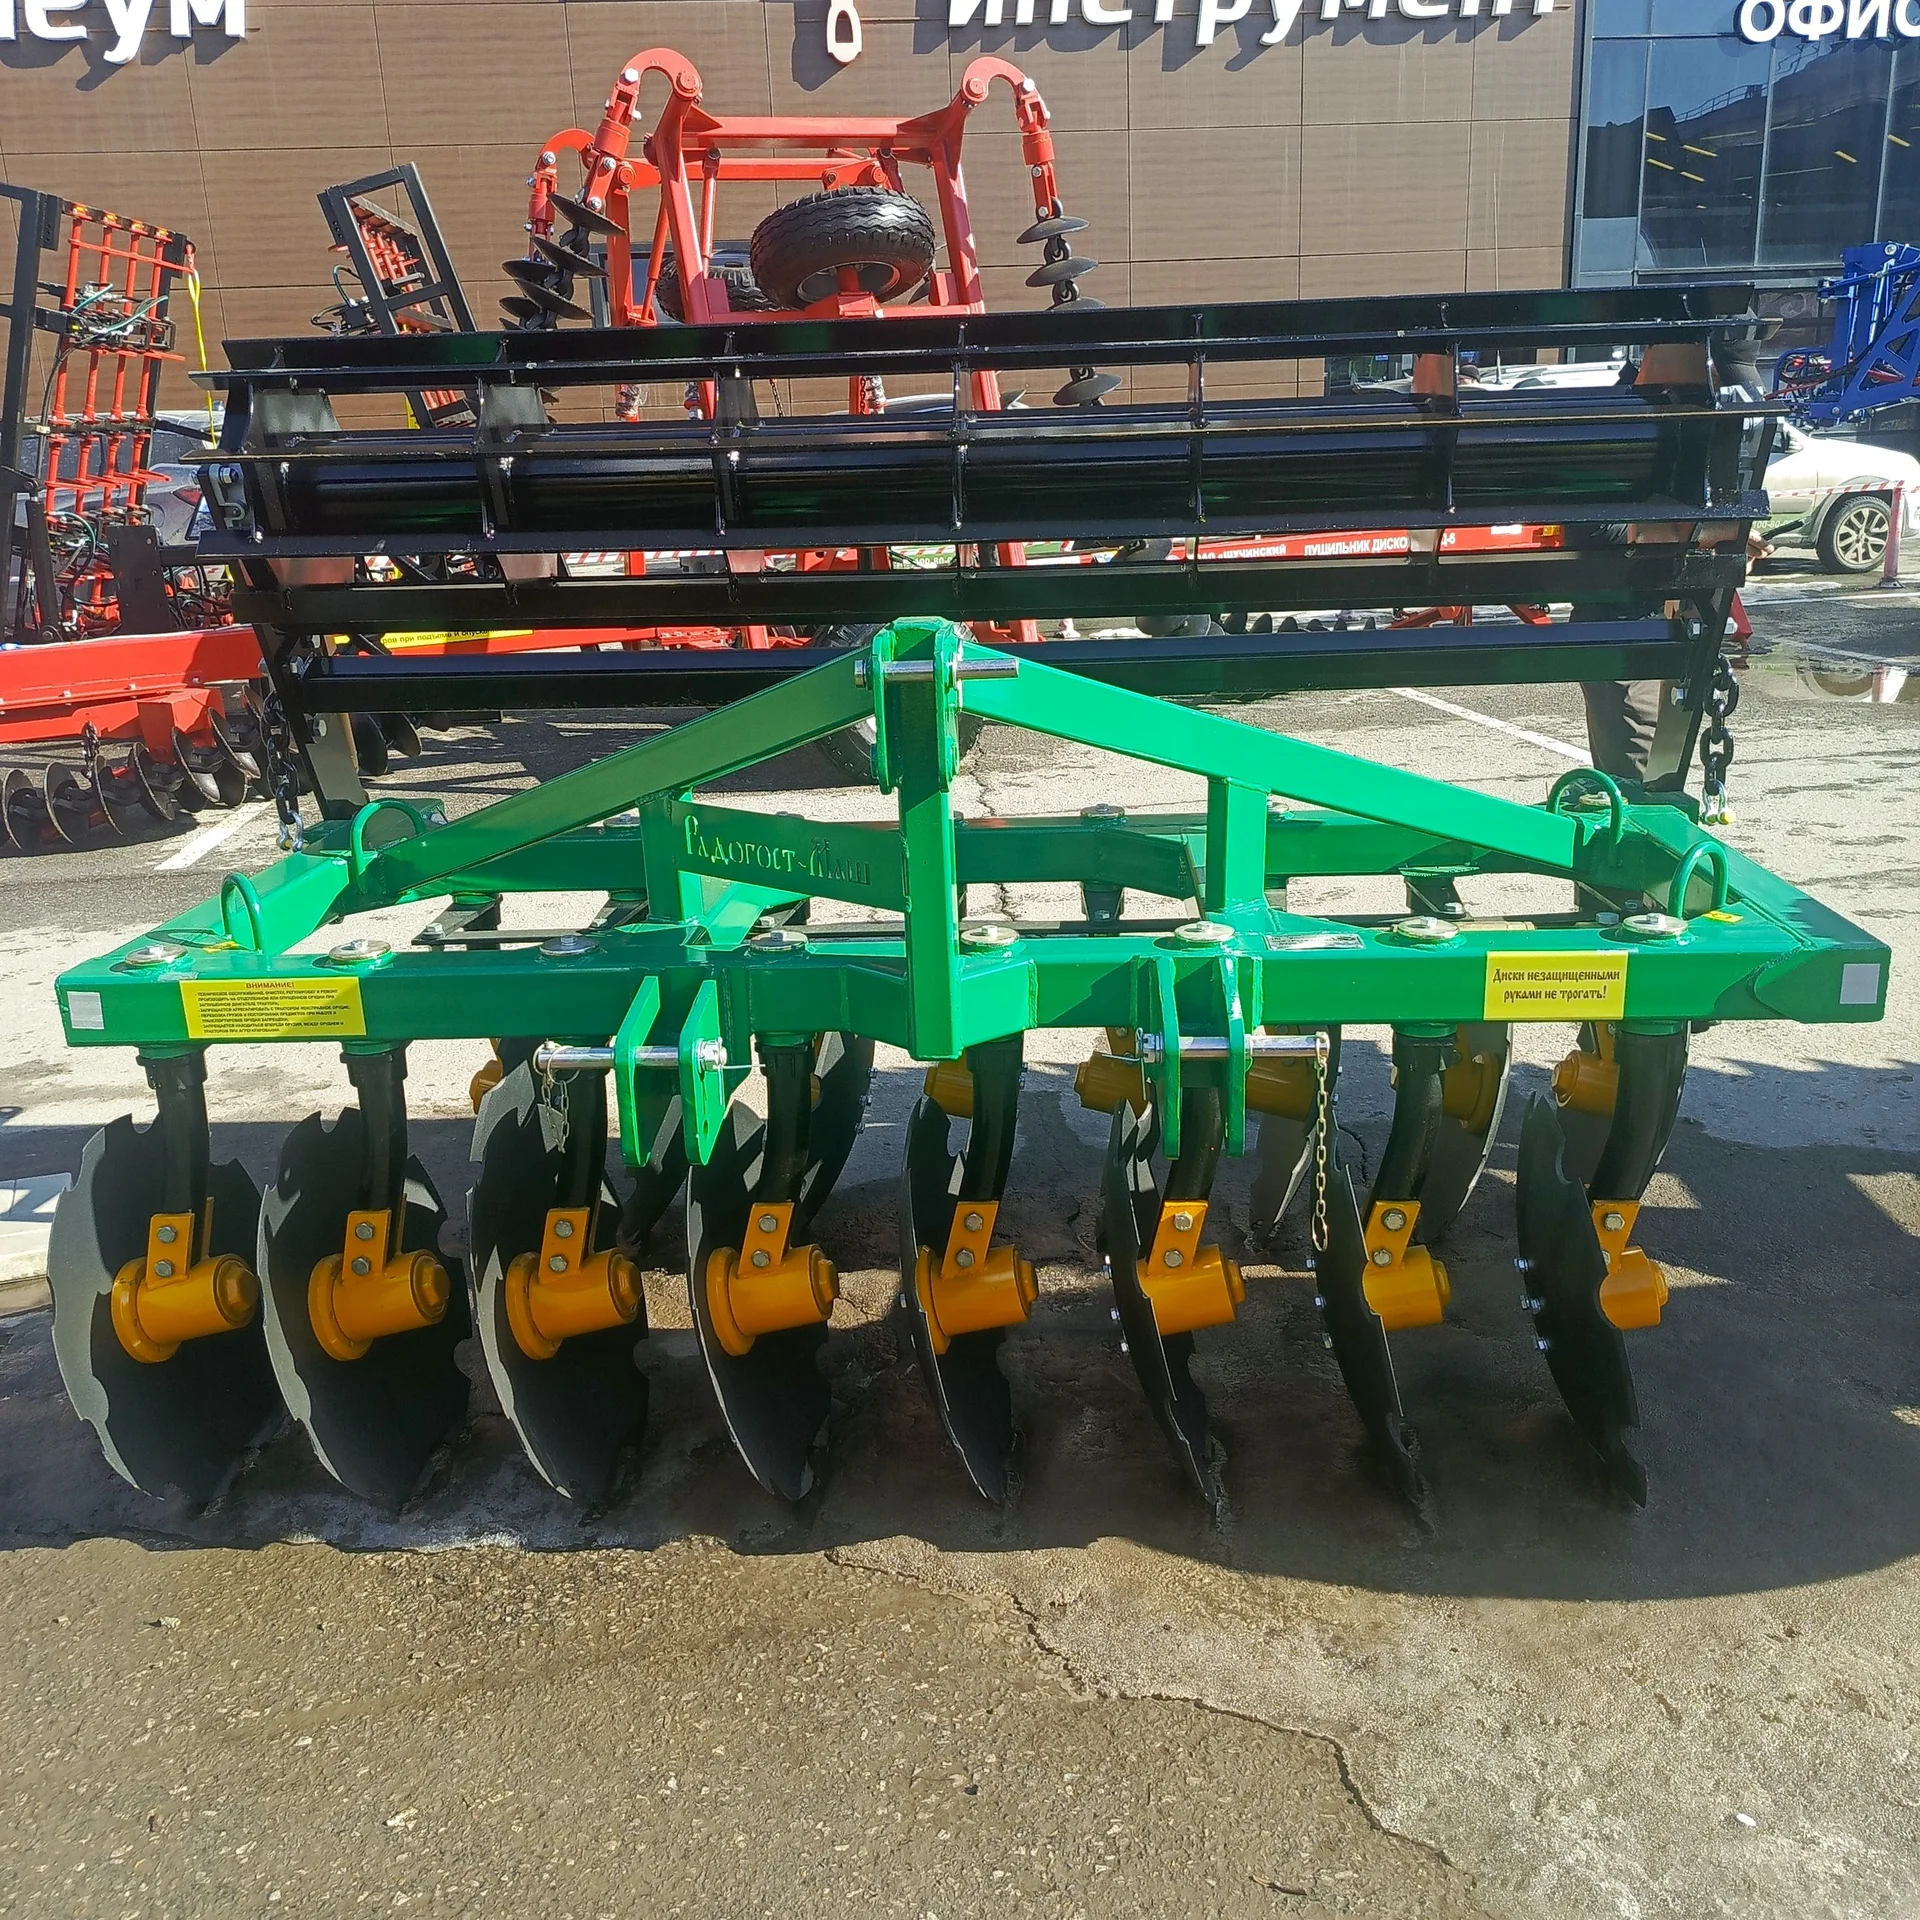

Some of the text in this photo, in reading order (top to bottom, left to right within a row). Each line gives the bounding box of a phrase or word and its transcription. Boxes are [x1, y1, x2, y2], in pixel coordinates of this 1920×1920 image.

[0, 0, 247, 65] еум
[1492, 968, 1620, 983] Диски незащищенными
[1503, 985, 1607, 1003] руками не трогать!
